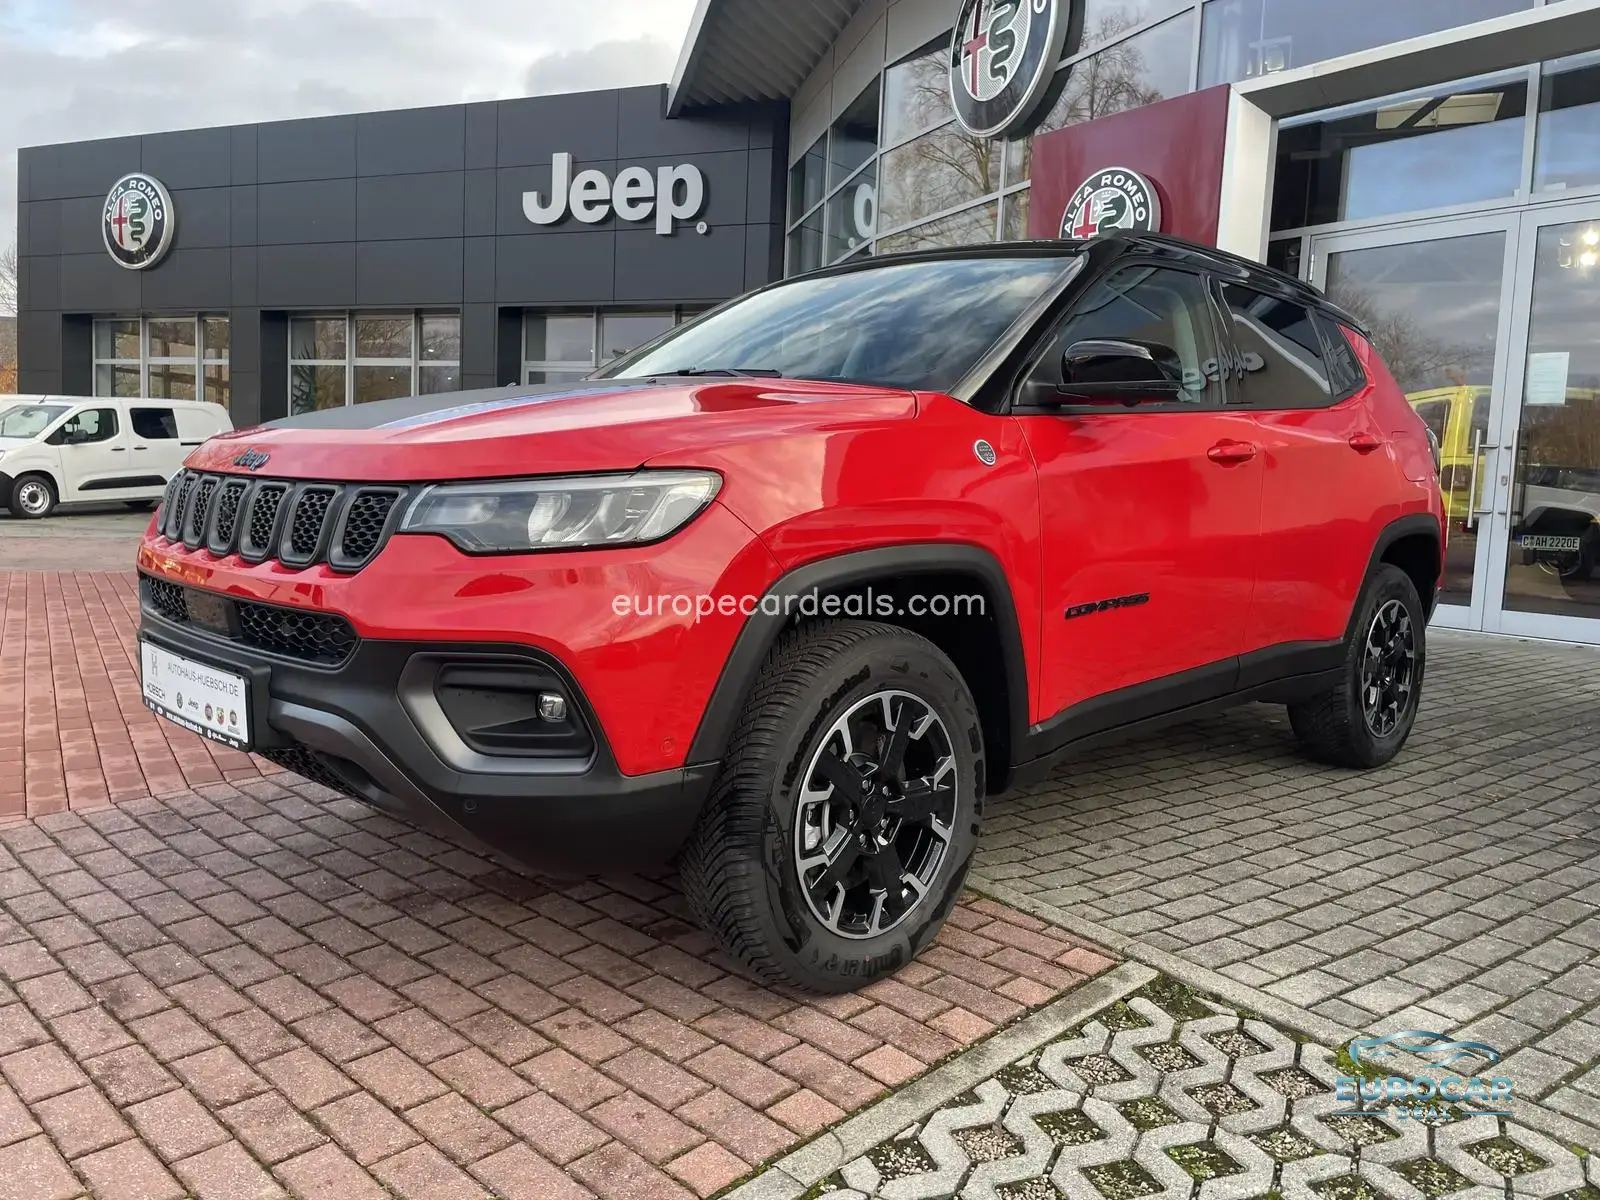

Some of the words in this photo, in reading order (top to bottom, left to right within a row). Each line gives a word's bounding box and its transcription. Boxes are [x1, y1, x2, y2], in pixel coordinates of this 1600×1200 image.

[105, 186, 125, 223] ALFA
[129, 180, 163, 221] ROMEO
[522, 152, 704, 235] Jeep
[1064, 186, 1093, 234] ALFA
[1101, 174, 1147, 222] ROMEO
[1535, 537, 1547, 547] AH
[1549, 537, 1578, 549] 2220E
